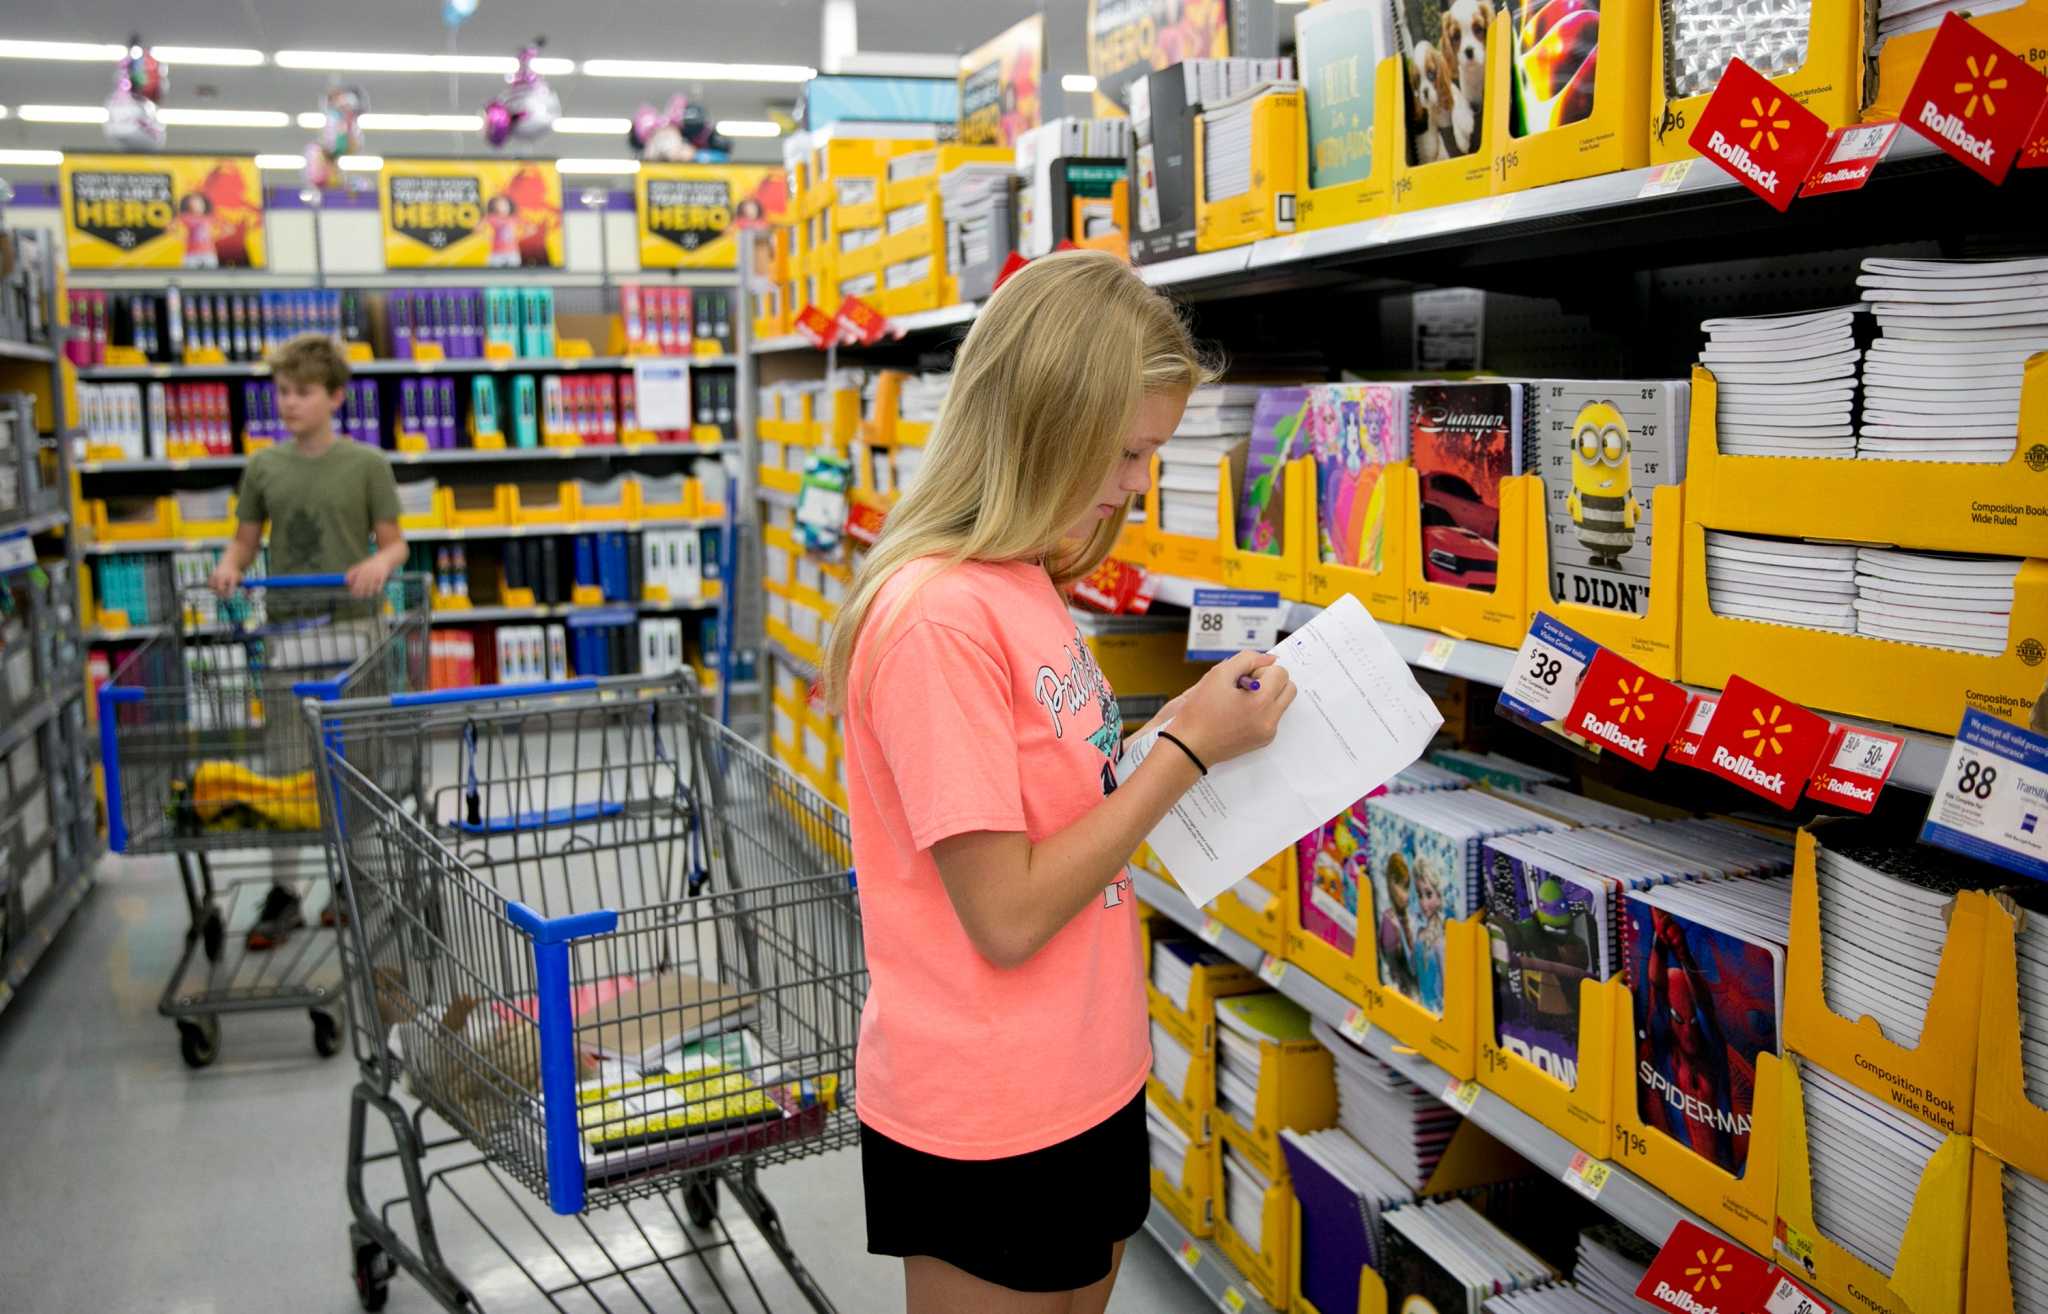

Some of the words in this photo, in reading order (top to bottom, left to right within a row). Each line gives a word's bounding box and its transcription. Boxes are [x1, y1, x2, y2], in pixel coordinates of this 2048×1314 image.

[2030, 48, 2048, 62] Bo
[1919, 100, 1996, 167] Rollback
[1707, 130, 1780, 194] Rollback
[1821, 165, 1869, 184] Rollback
[76, 200, 174, 230] HERO
[394, 202, 481, 229] HERO
[648, 205, 731, 231] HERO
[1971, 500, 2024, 514] Composition
[1971, 512, 1993, 525] Wide
[1993, 513, 2017, 526] Ruled
[1557, 572, 1566, 600] I
[1965, 689, 2019, 707] Composition
[2019, 697, 2036, 709] Bo
[1581, 711, 1648, 757] Rollback
[1966, 731, 1980, 744] and
[1979, 736, 1995, 749] most
[1969, 717, 1982, 731] We
[1981, 722, 2002, 739] accept
[1863, 744, 1883, 767] 50¢
[1712, 745, 1786, 795] Rollback
[1957, 756, 1997, 800] $88
[1827, 778, 1875, 802] Rollback
[1854, 1053, 1923, 1098] Composition
[1925, 1089, 1955, 1115] Book
[1891, 1088, 1921, 1113] Wide
[1922, 1105, 1955, 1132] Ruled
[1653, 1280, 1721, 1314] Rollbac
